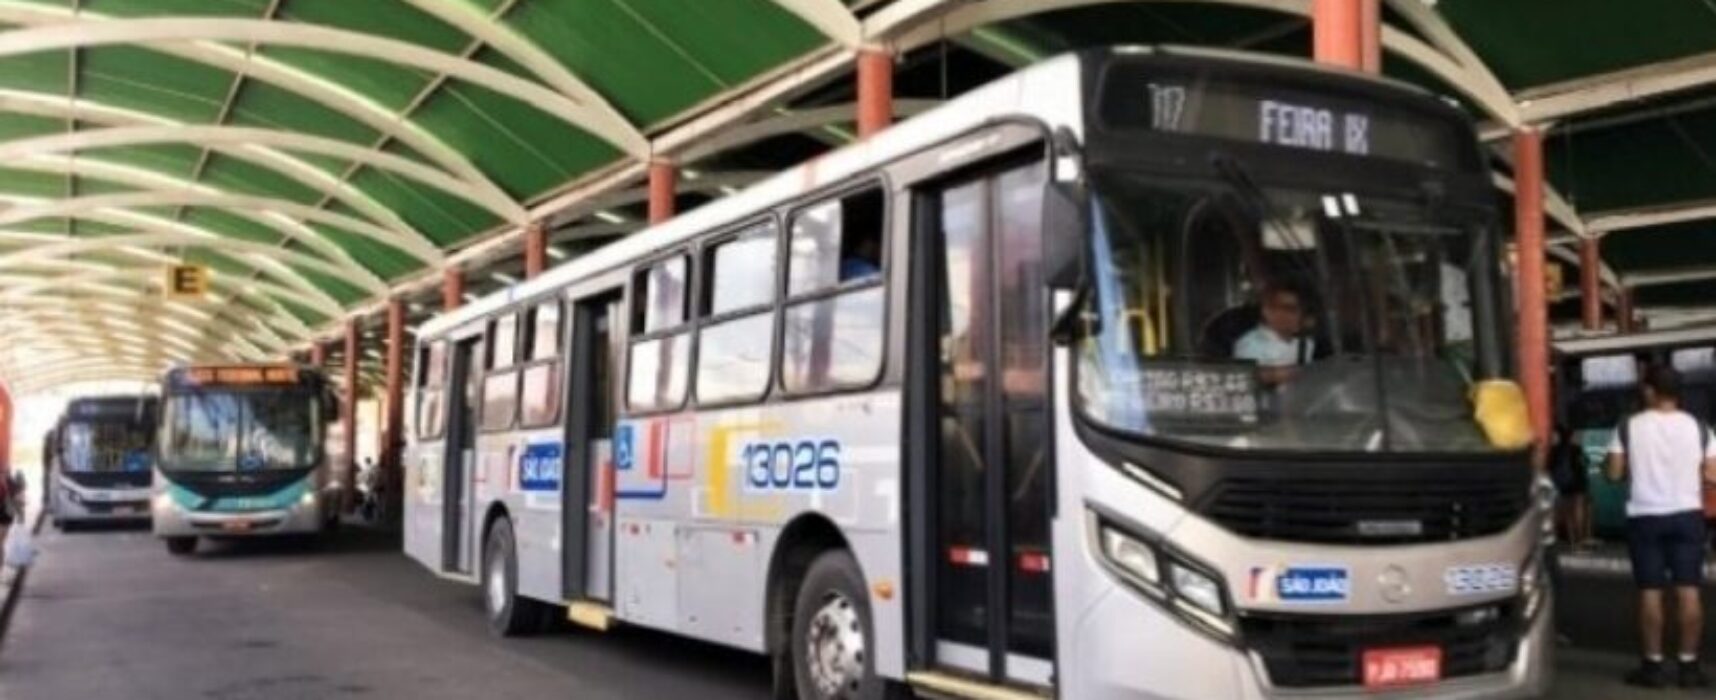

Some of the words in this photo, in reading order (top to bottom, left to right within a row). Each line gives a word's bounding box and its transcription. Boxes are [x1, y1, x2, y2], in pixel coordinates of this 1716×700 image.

[1260, 100, 1332, 150] FEIRA
[1344, 113, 1368, 155] IX
[174, 266, 201, 294] E
[742, 440, 840, 489] 13026
[1281, 571, 1309, 593] SÃO
[1312, 571, 1349, 593] JOÃO
